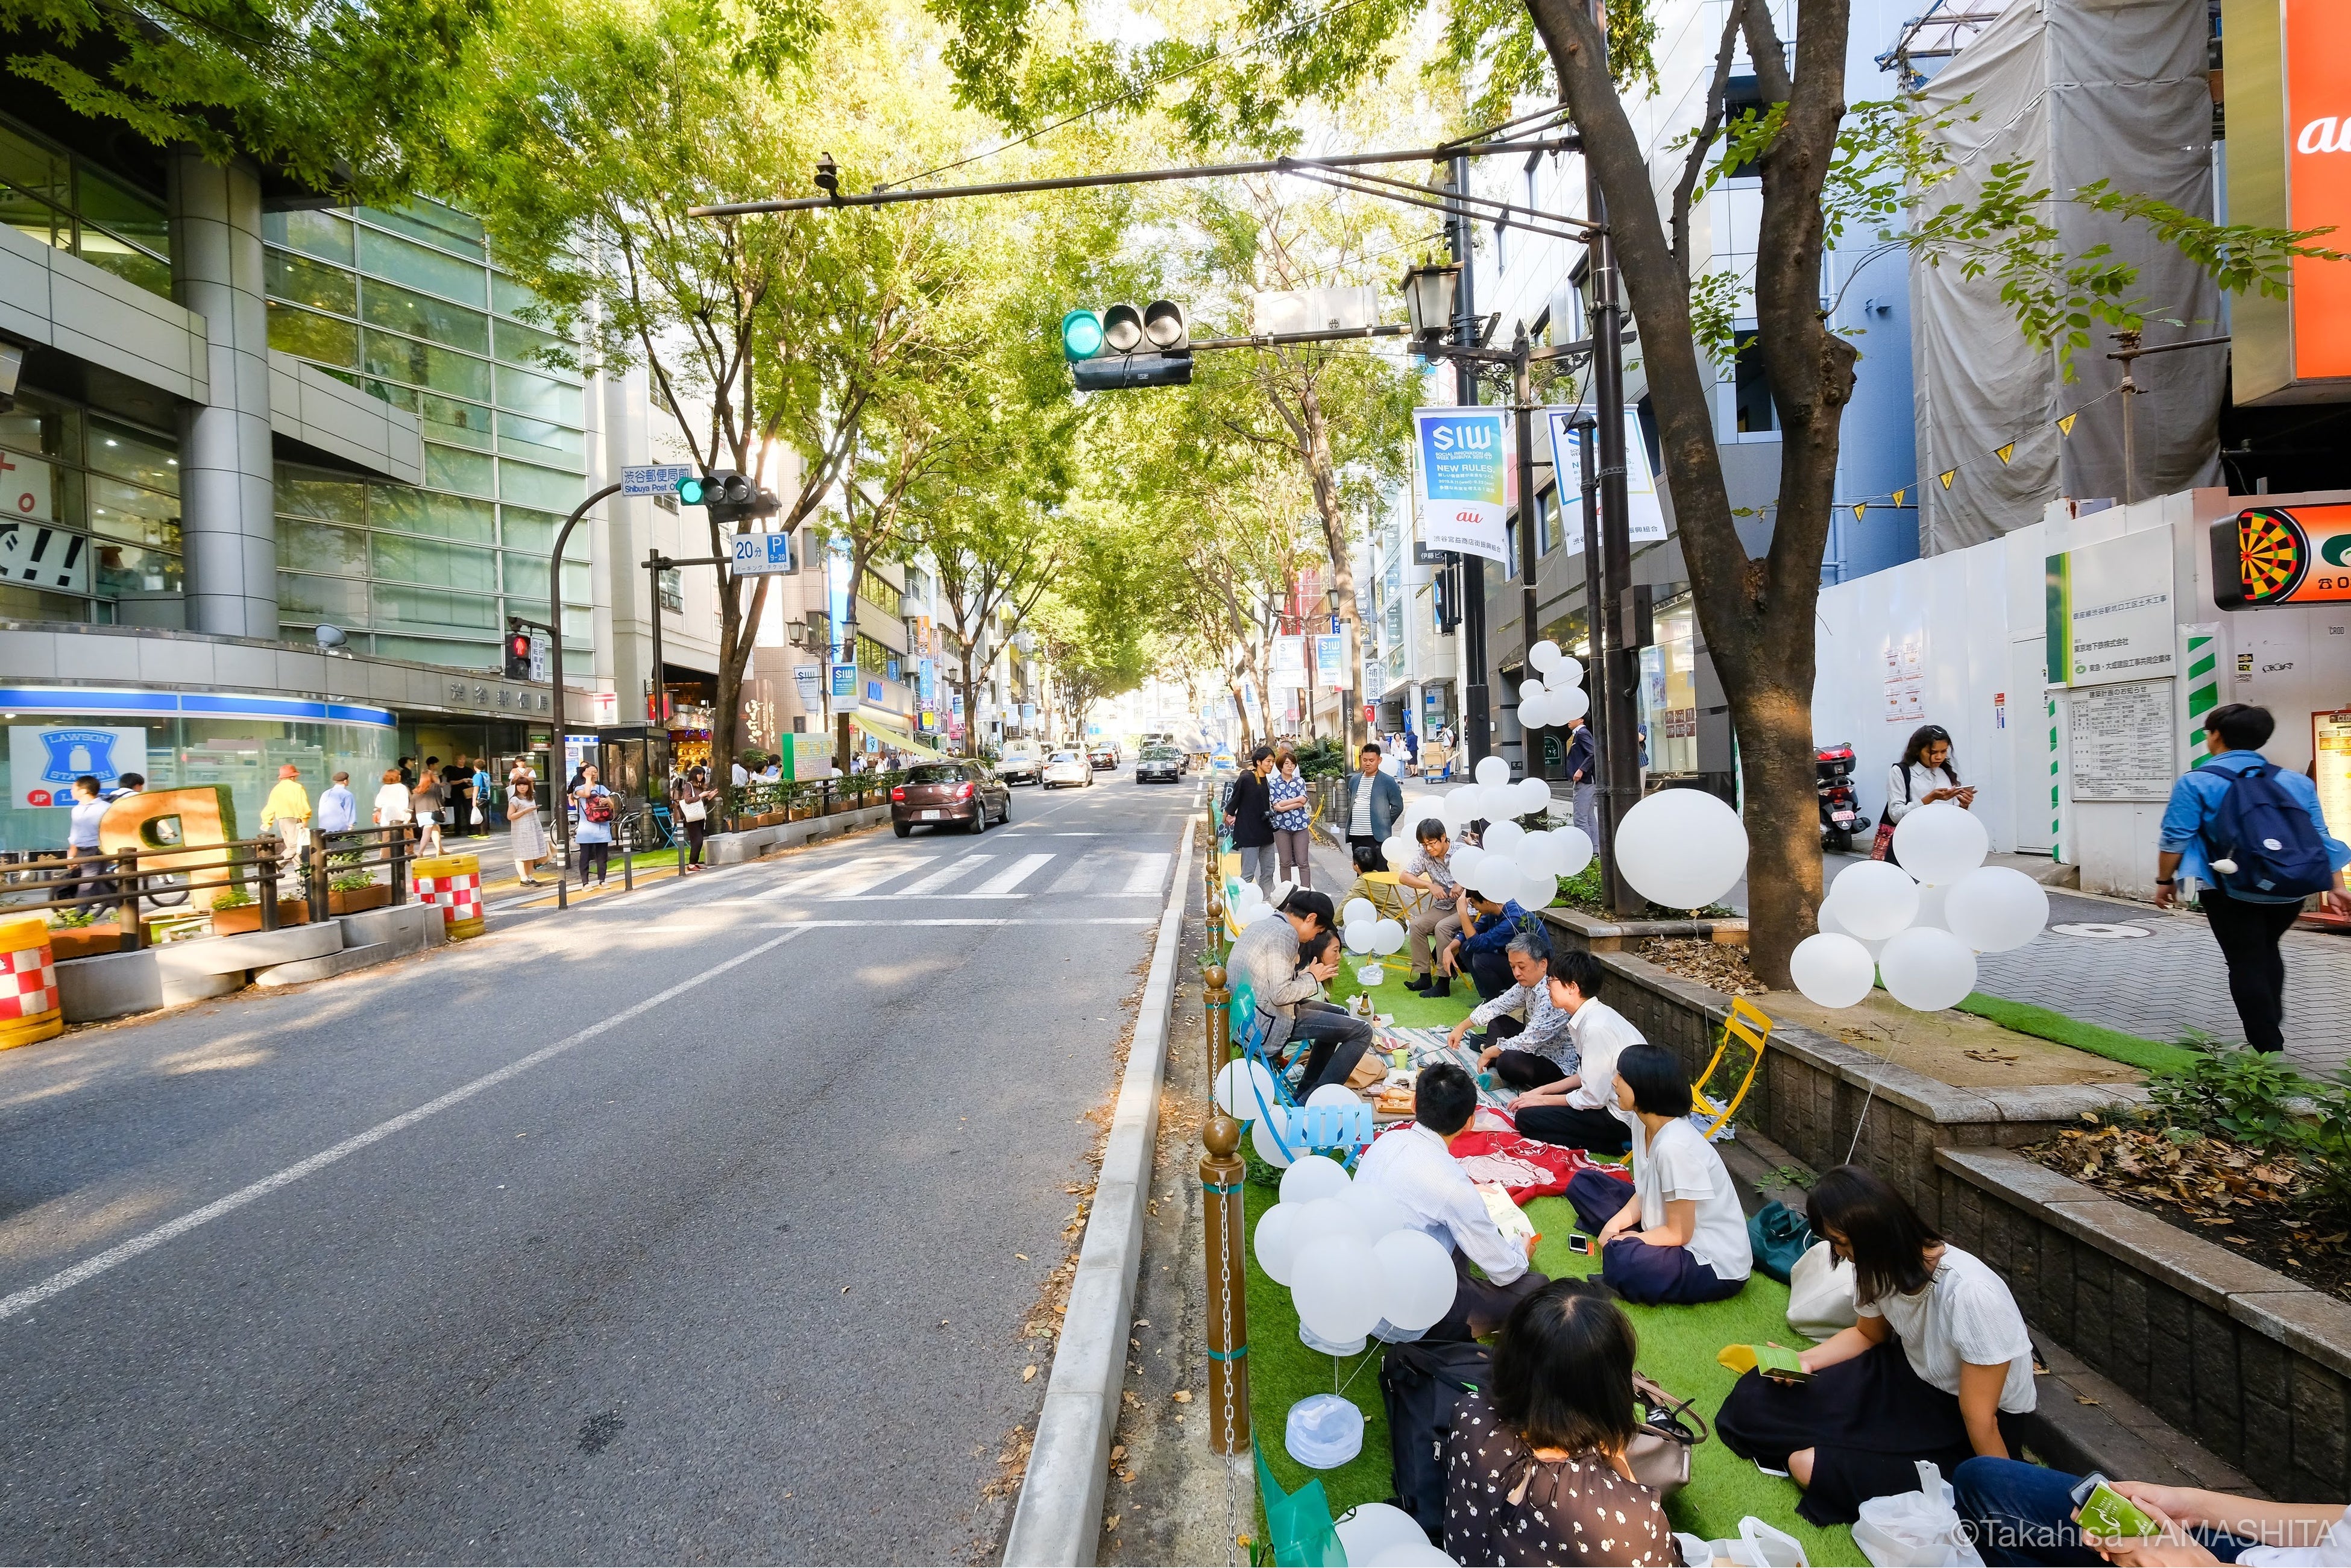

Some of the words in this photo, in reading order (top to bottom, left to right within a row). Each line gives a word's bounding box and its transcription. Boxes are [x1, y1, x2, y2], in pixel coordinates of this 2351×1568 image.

[1433, 425, 1491, 451] SIW
[1462, 464, 1495, 473] RULES.
[625, 484, 650, 494] Shibuya
[1456, 512, 1484, 523] au
[772, 536, 782, 552] P
[1434, 535, 1501, 553] 渋谷宮益商店街振興組合
[770, 553, 785, 562] 9-20
[735, 564, 789, 572] パーキング・チケット
[2074, 637, 2129, 653] 東京地下鉄株式会社
[836, 669, 854, 679] SIW
[1368, 668, 1379, 697] 補聴器
[451, 681, 549, 713] 渋谷郵便局
[2089, 686, 2147, 698] 建築計画のお知らせ
[48, 733, 112, 745] LAWSON
[33, 794, 48, 802] JP
